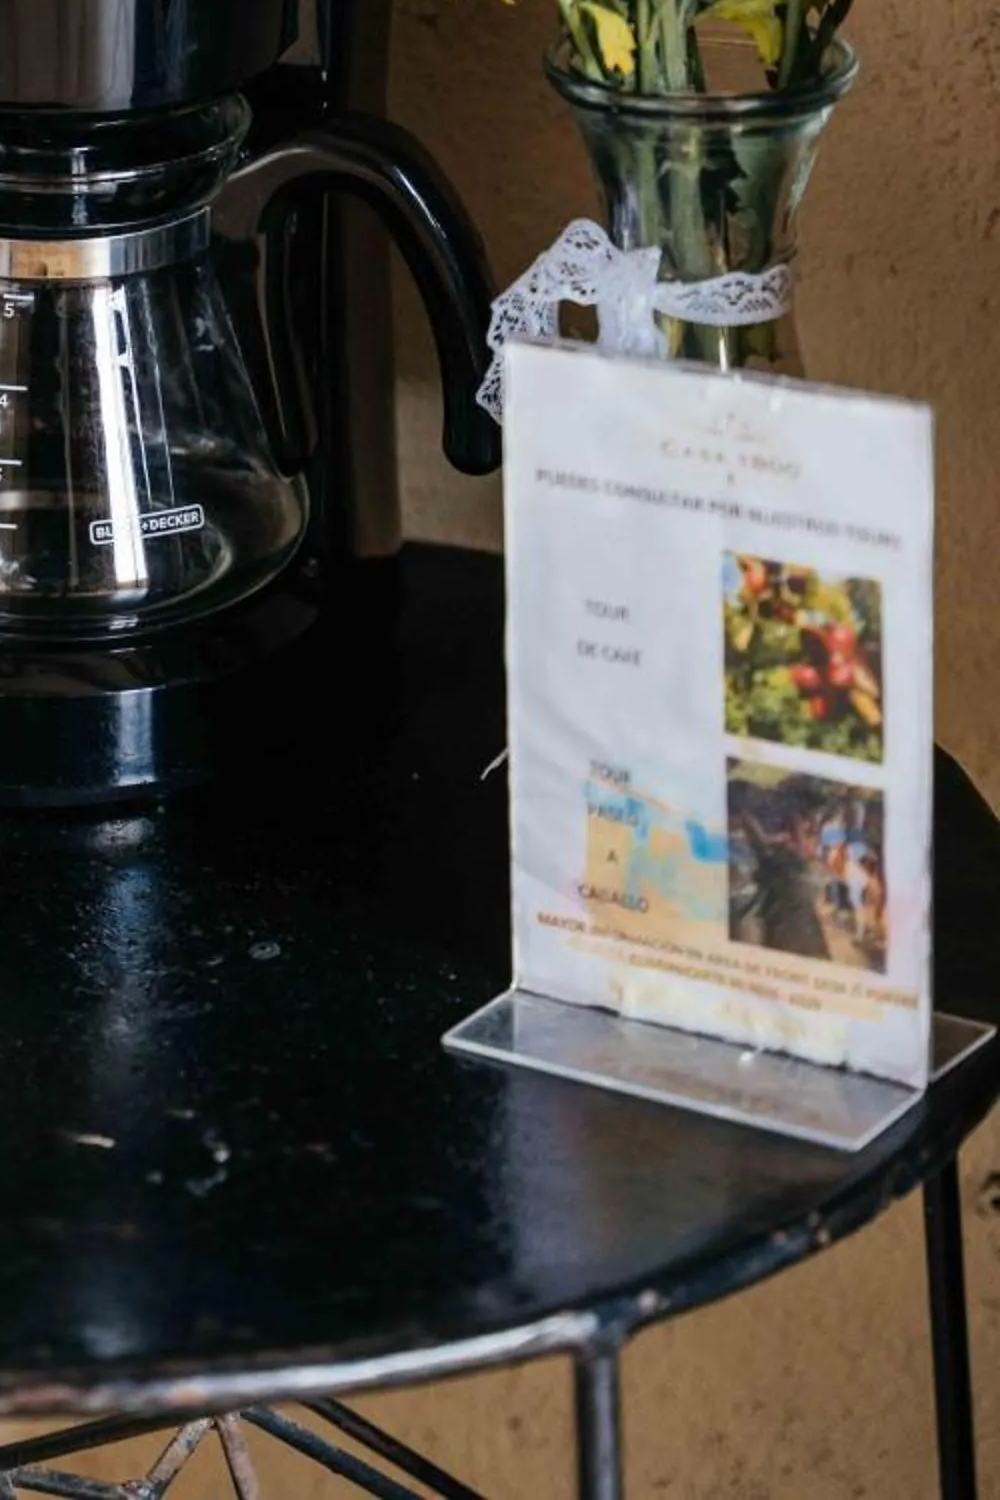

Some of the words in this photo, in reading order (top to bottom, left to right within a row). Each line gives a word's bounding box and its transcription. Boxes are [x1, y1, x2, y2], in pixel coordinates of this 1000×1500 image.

[3, 302, 15, 318] 5
[95, 511, 199, 539] BL+DECKER
[606, 849, 619, 865] A
